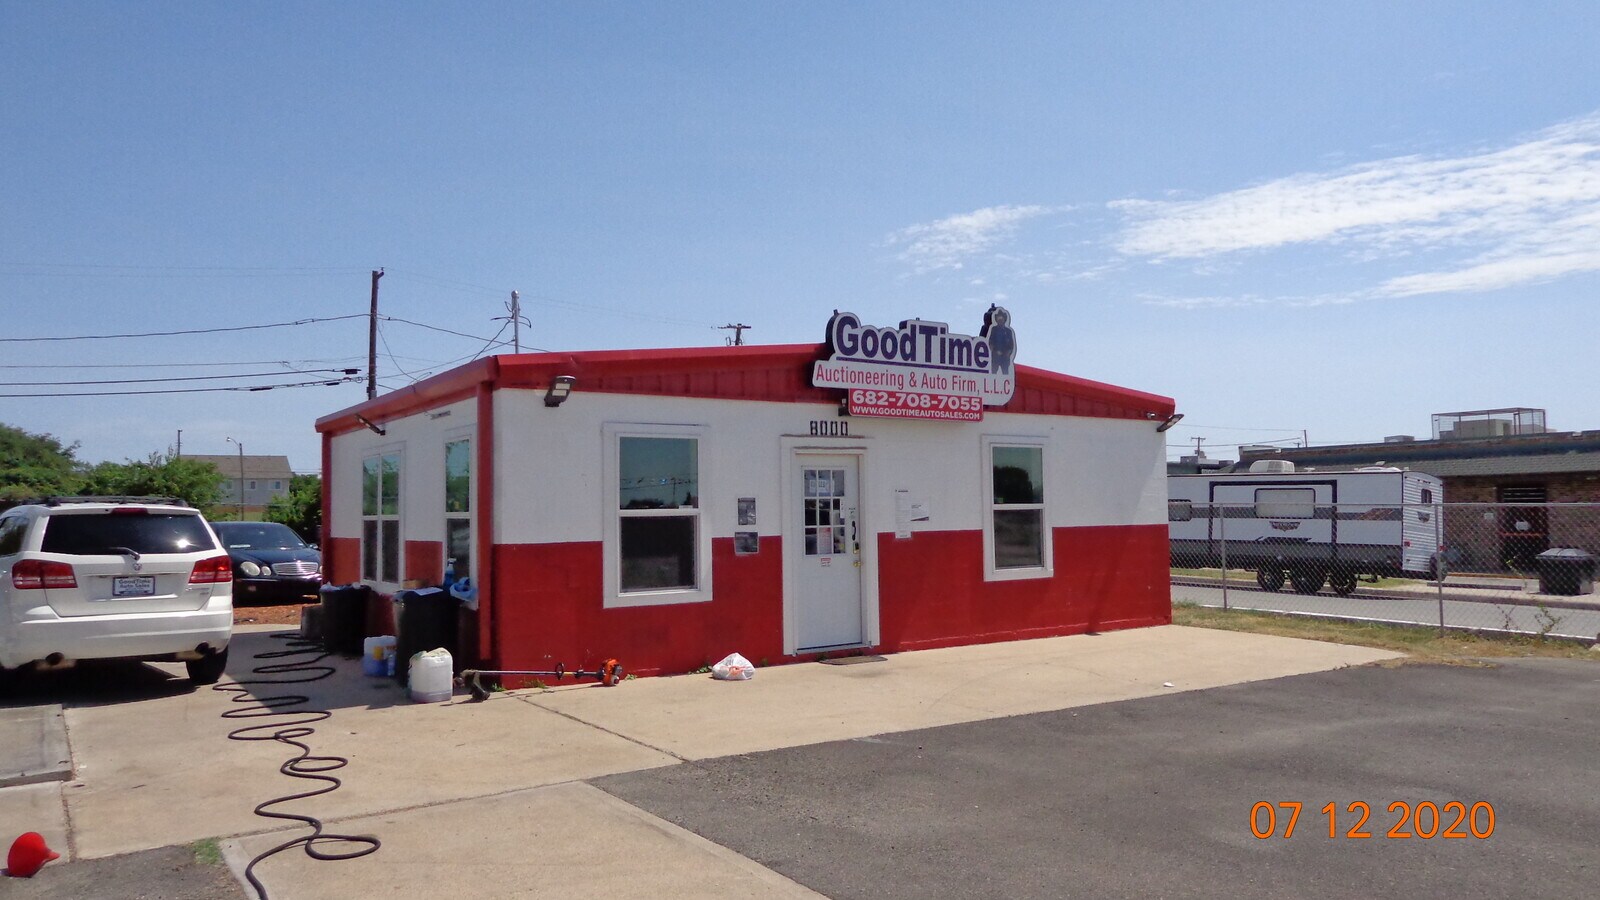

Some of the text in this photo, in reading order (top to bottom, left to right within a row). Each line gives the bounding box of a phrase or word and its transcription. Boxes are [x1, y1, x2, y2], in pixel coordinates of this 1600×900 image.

[836, 316, 989, 368] GoodTime
[816, 364, 1011, 396] Auctioneering & Auto Firm, L.L.C
[852, 390, 981, 411] 682-708-7055
[852, 405, 980, 420] WWW.GOODTIMEAUTOSALES.COM
[809, 420, 849, 436] 8000
